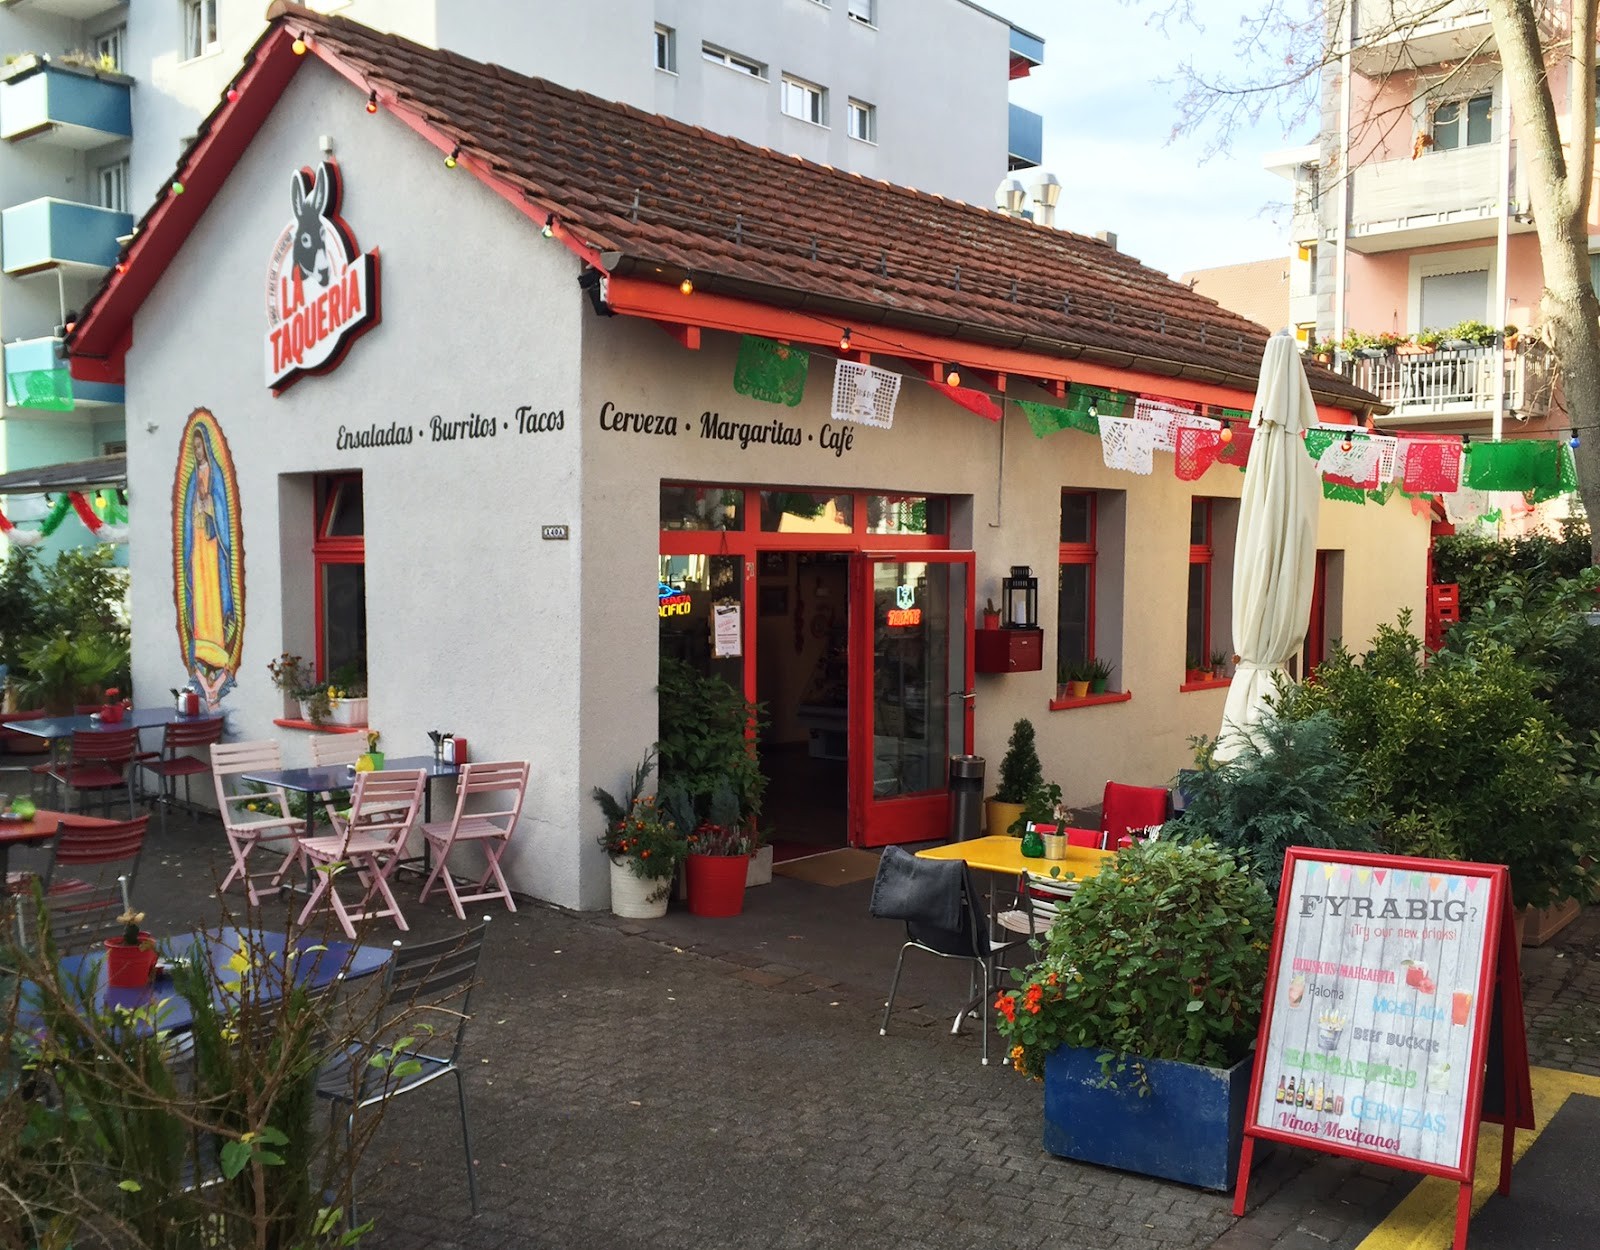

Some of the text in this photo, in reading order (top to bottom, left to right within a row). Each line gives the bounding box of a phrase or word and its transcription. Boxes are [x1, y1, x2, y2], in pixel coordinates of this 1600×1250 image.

[282, 263, 305, 320] LA
[270, 264, 362, 374] TAQUERÍA
[336, 406, 565, 451] Ensaladas Burritos Tacos
[599, 401, 856, 457] Cerveza Margaritas Café
[658, 602, 691, 617] ACIFICO
[1374, 927, 1394, 938] our
[1308, 983, 1345, 1000] Paloma
[1279, 1111, 1403, 1151] Vinos Mexicanos
[1351, 1095, 1448, 1135] CERVEZAS
